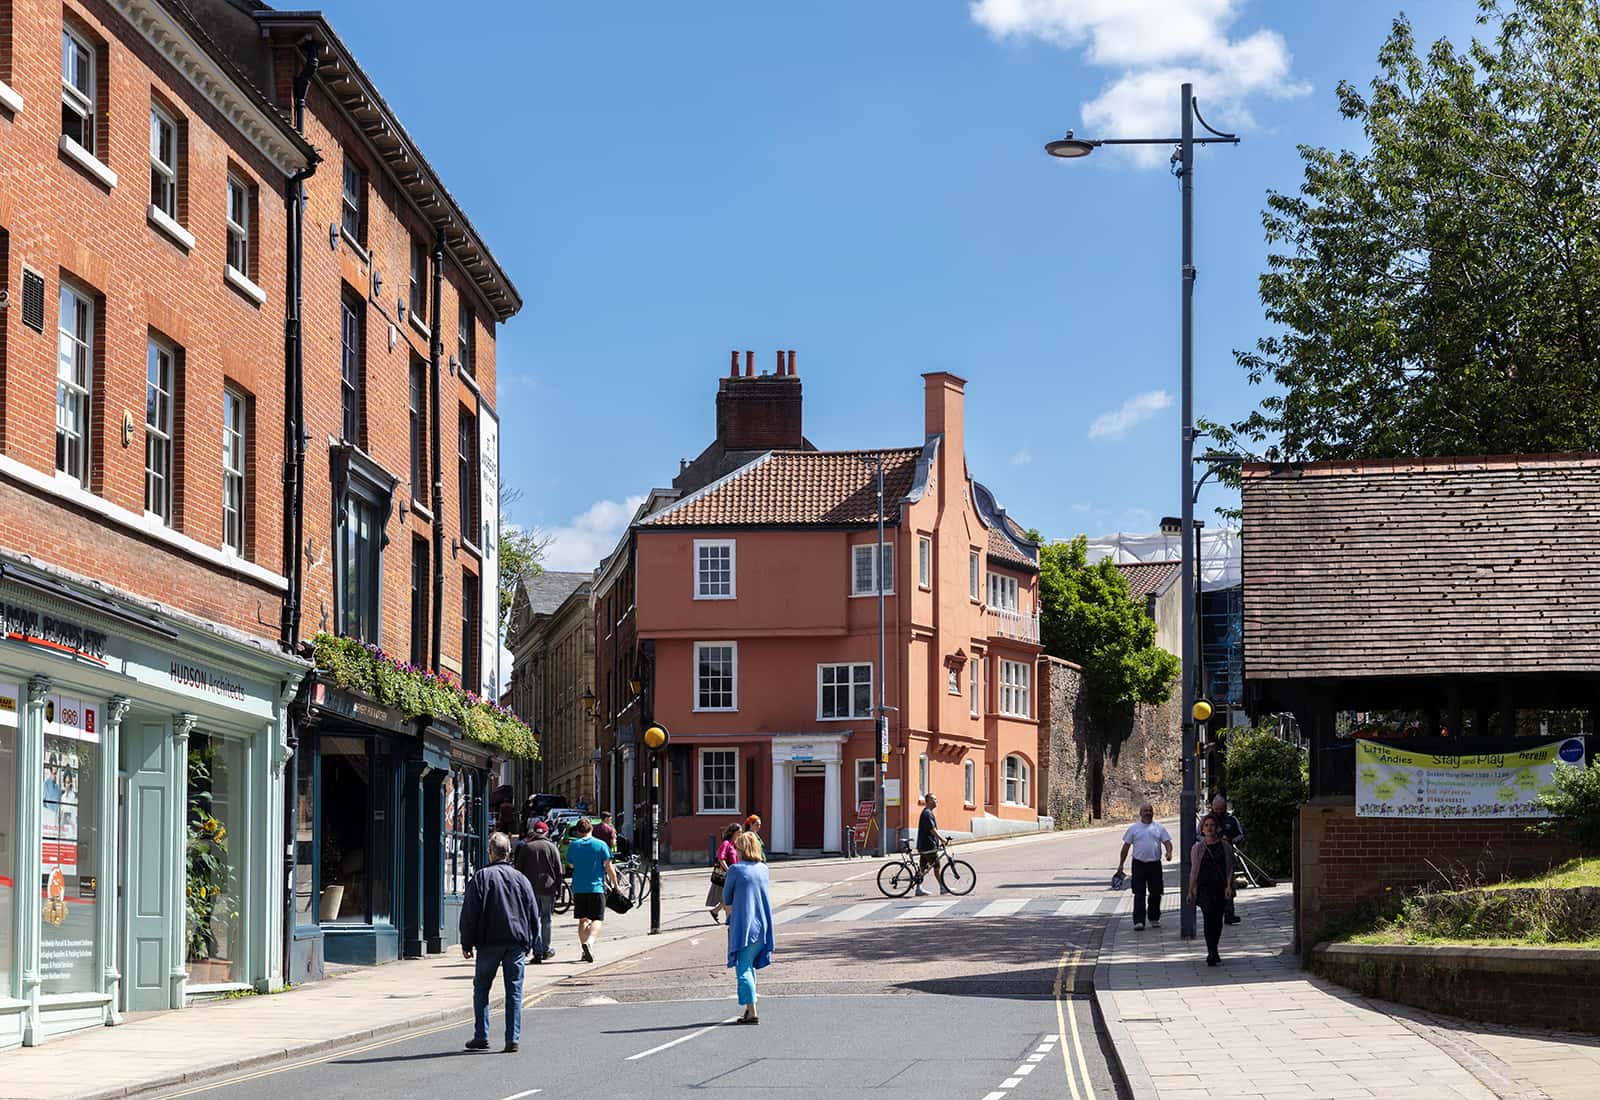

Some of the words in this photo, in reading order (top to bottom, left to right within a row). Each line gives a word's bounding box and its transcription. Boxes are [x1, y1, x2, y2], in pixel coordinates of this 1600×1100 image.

[170, 661, 207, 691] HUDSON
[208, 673, 245, 702] Architects
[1363, 744, 1391, 754] Little
[1380, 754, 1413, 764] Andies
[1432, 755, 1460, 768] Stay
[1477, 754, 1504, 768] Play
